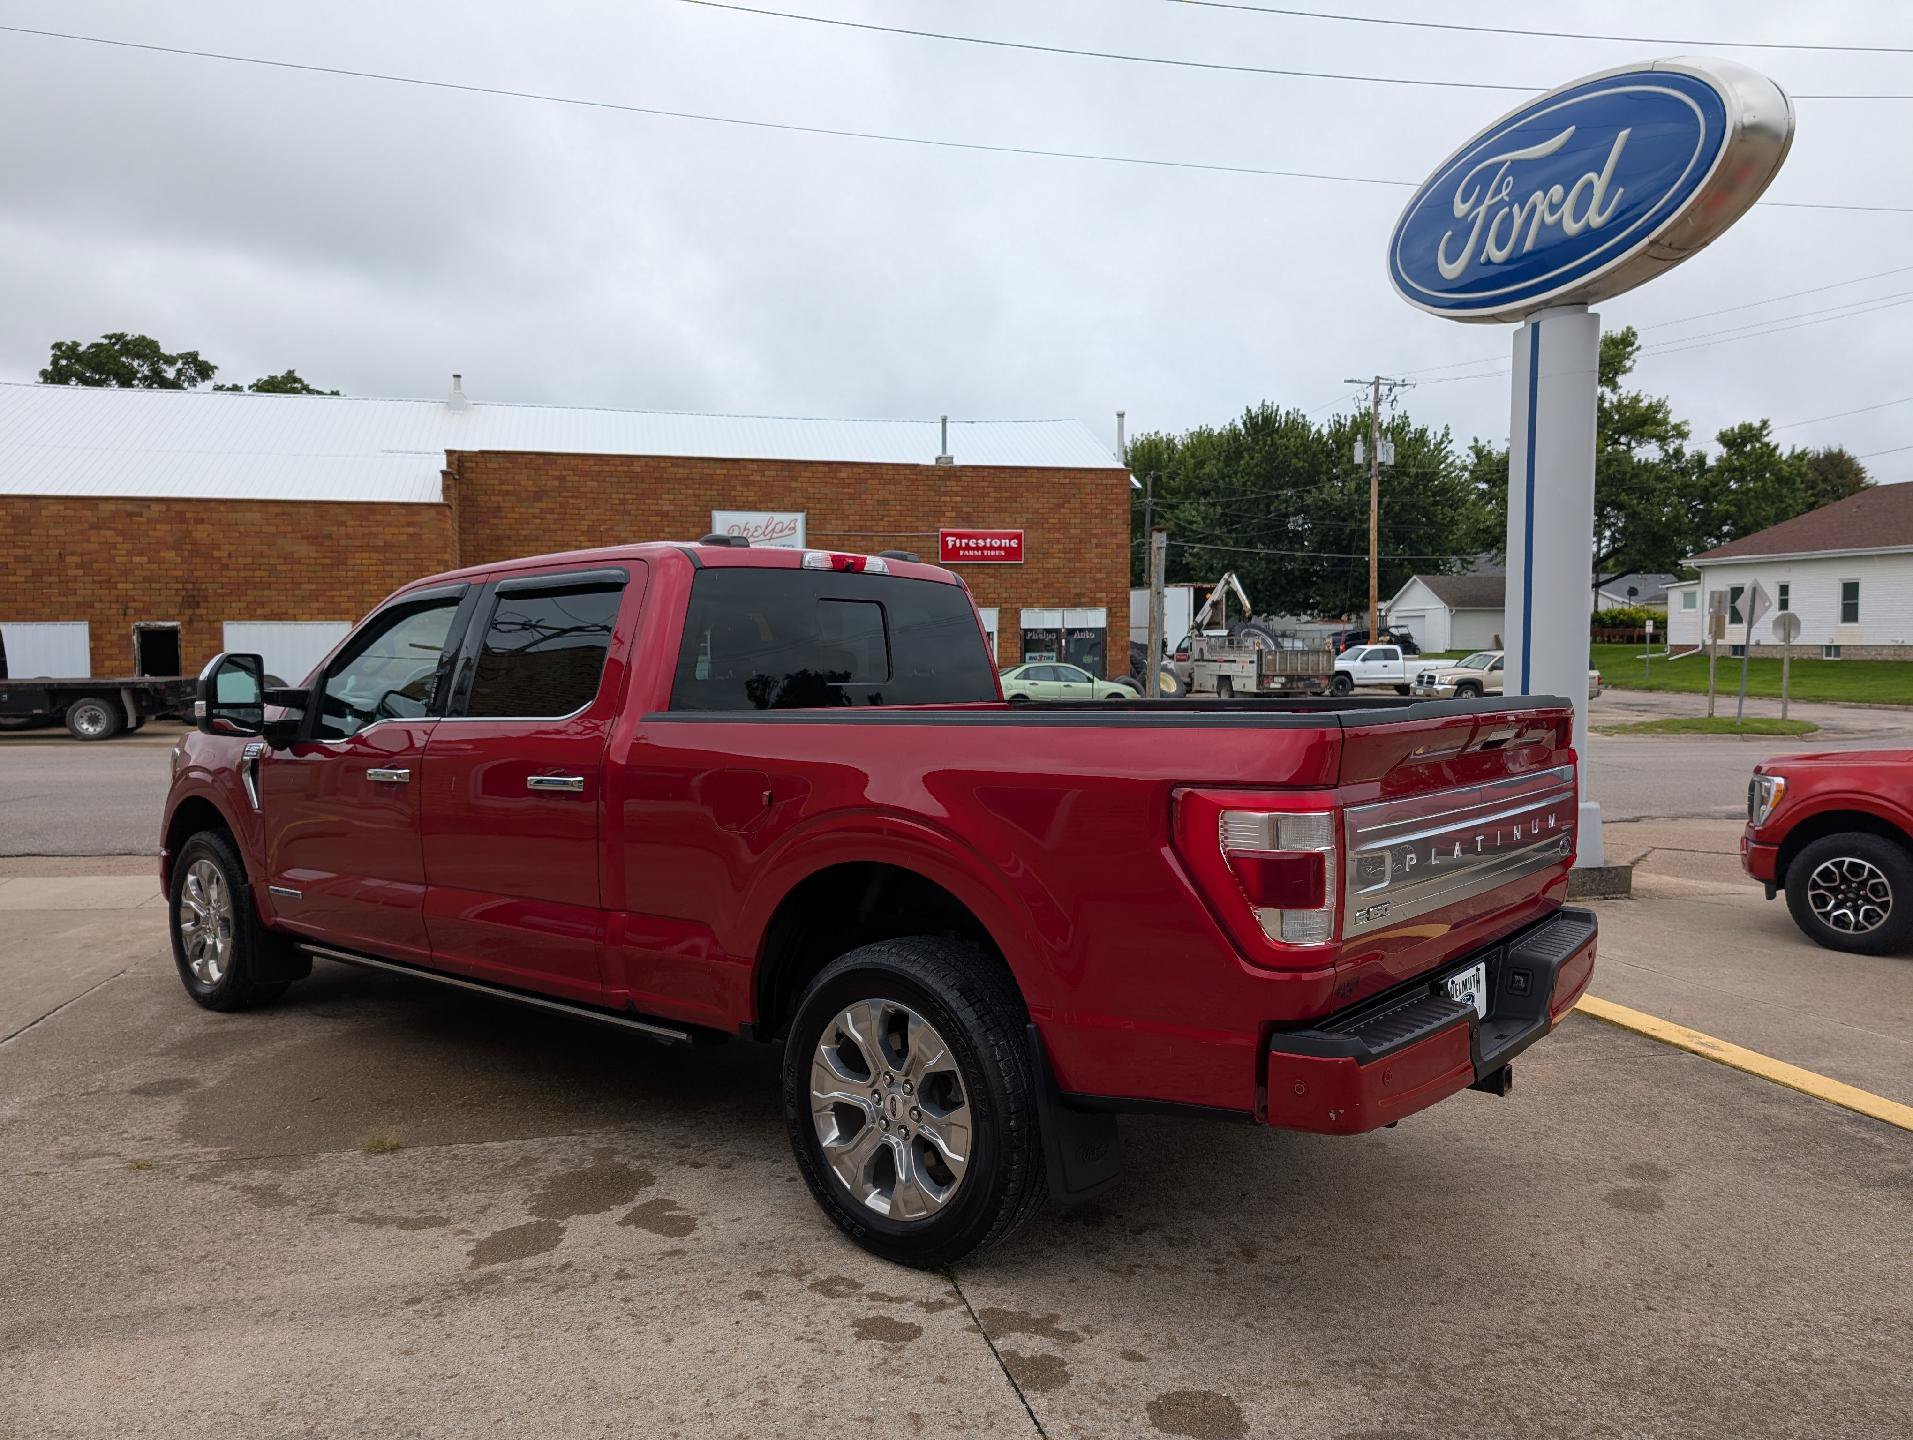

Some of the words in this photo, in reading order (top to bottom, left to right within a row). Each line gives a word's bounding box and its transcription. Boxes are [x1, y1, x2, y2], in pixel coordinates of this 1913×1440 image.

[1437, 125, 1632, 281] Ford
[727, 515, 798, 543] Phelps
[945, 536, 1019, 549] Firestone
[1073, 630, 1095, 639] Auto
[1405, 813, 1556, 872] PLATINUM
